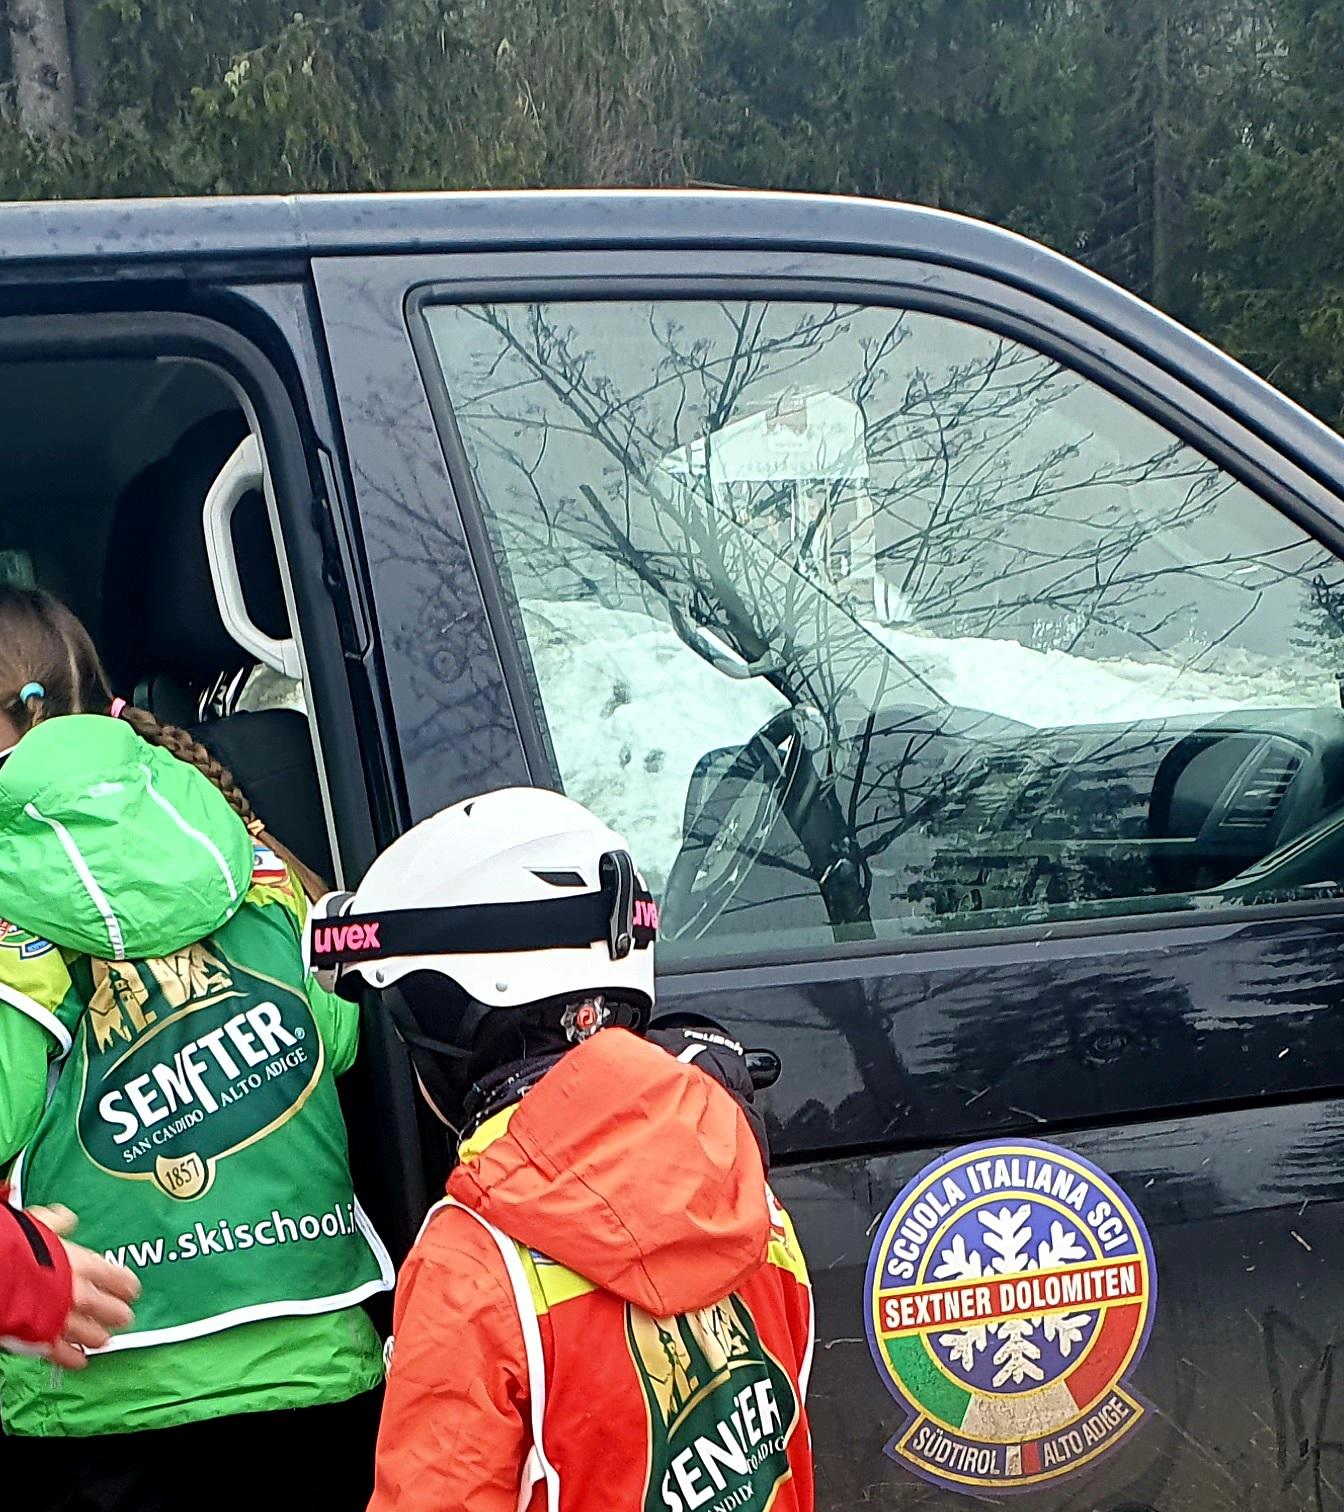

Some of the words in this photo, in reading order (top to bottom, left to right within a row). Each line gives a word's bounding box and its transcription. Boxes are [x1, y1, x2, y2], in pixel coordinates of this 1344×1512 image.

[314, 921, 381, 953] uvex
[99, 1001, 296, 1144] SENFTER
[123, 1139, 152, 1163] SAN
[152, 1110, 205, 1146] CANDIDO
[220, 1073, 262, 1107] ALTO
[266, 1047, 308, 1081] ADIGE
[165, 1158, 201, 1191] 1857
[888, 1180, 965, 1280] SCUOLA
[966, 1158, 1090, 1212] ITALIANA
[1087, 1202, 1129, 1252] SCI
[884, 1286, 992, 1329] SEXTNER
[999, 1264, 1137, 1312] DOLOMITEN
[913, 1426, 1001, 1476] SÜDTIROL
[1043, 1430, 1084, 1467] ALTO
[1083, 1396, 1131, 1446] ADIGE
